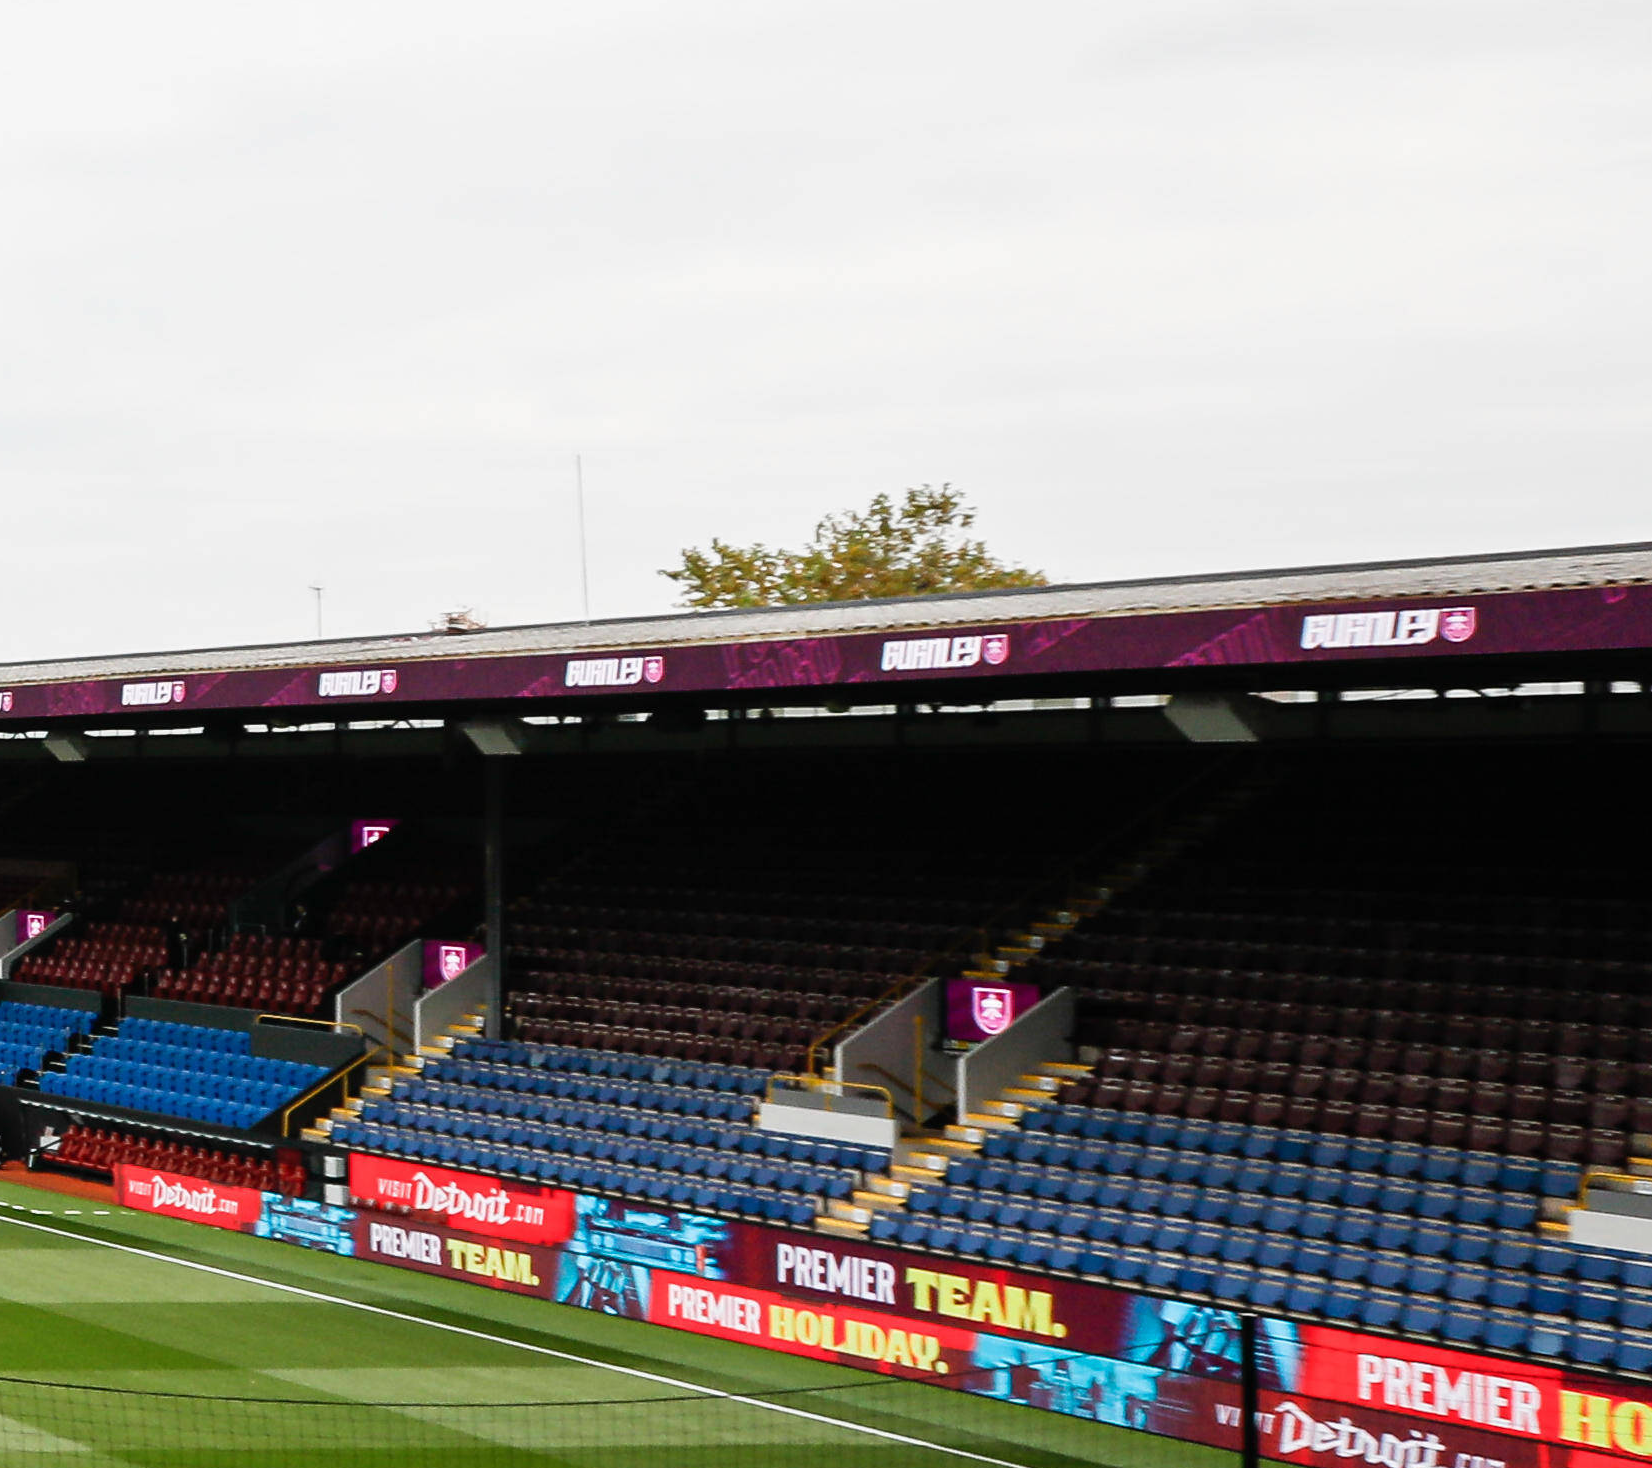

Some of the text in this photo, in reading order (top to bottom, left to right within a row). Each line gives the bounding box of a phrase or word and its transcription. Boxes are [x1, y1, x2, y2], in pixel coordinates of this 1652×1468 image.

[377, 1177, 411, 1200] VISIT
[370, 1222, 541, 1287] PREMIER TEAM.
[776, 1243, 1067, 1339] PREMIER TEAM.
[667, 1283, 948, 1375] PREMIER HOLIDAY.
[1356, 1353, 1542, 1435] PREMIER
